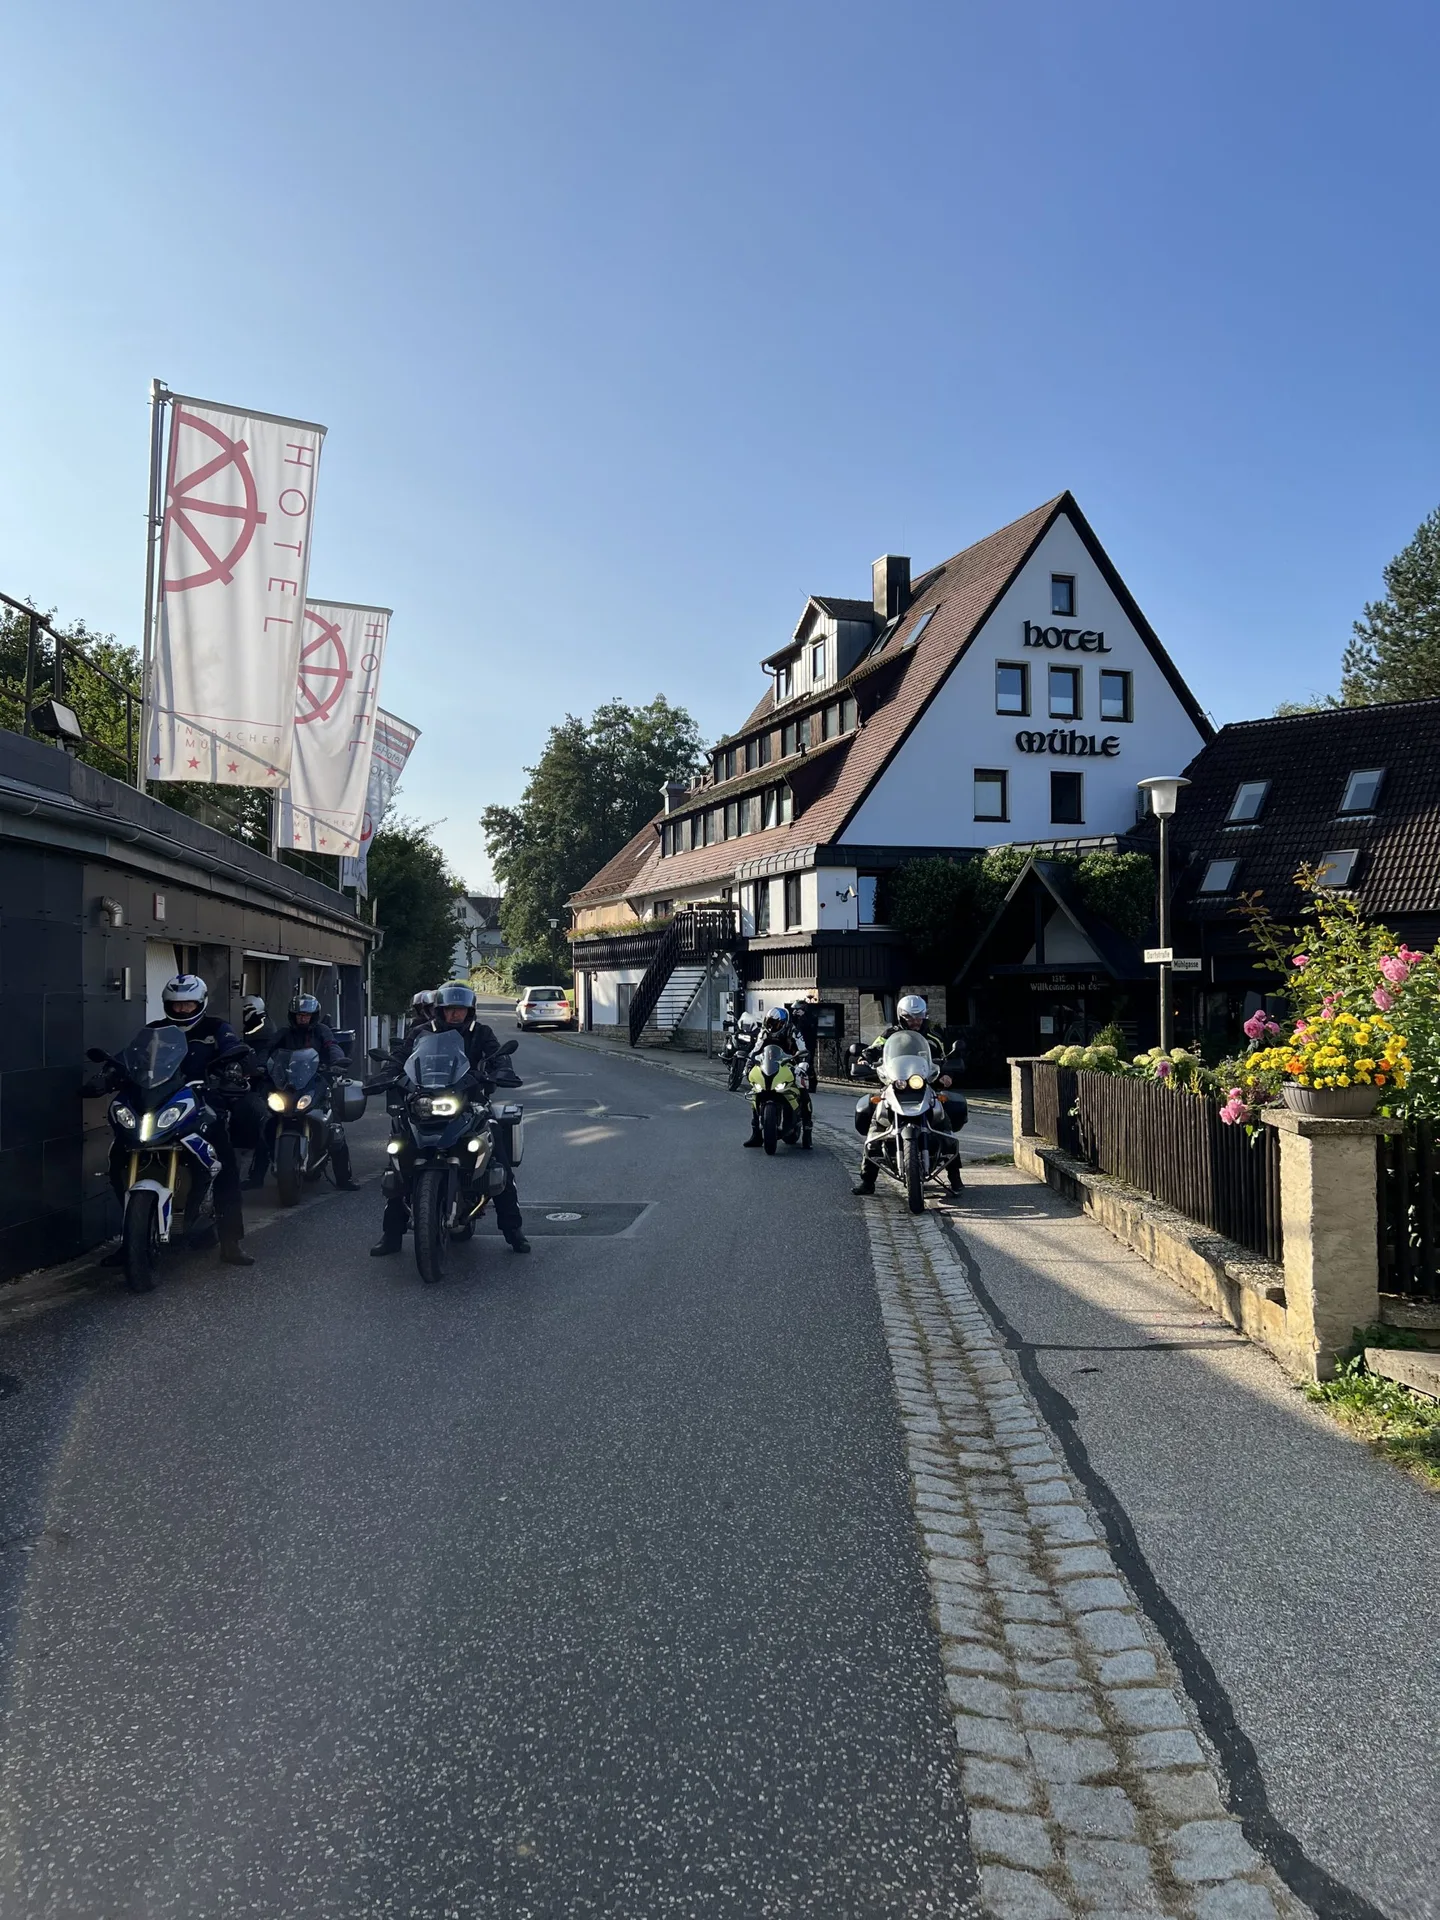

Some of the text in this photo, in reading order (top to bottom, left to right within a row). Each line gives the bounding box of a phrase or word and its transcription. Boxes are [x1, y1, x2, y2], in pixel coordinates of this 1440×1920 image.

[264, 443, 314, 633] HOTEL
[348, 623, 384, 752] HOTEL
[1029, 982, 1075, 991] Willkommen
[1078, 981, 1085, 991] in
[1173, 960, 1199, 970] Mühlgasse
